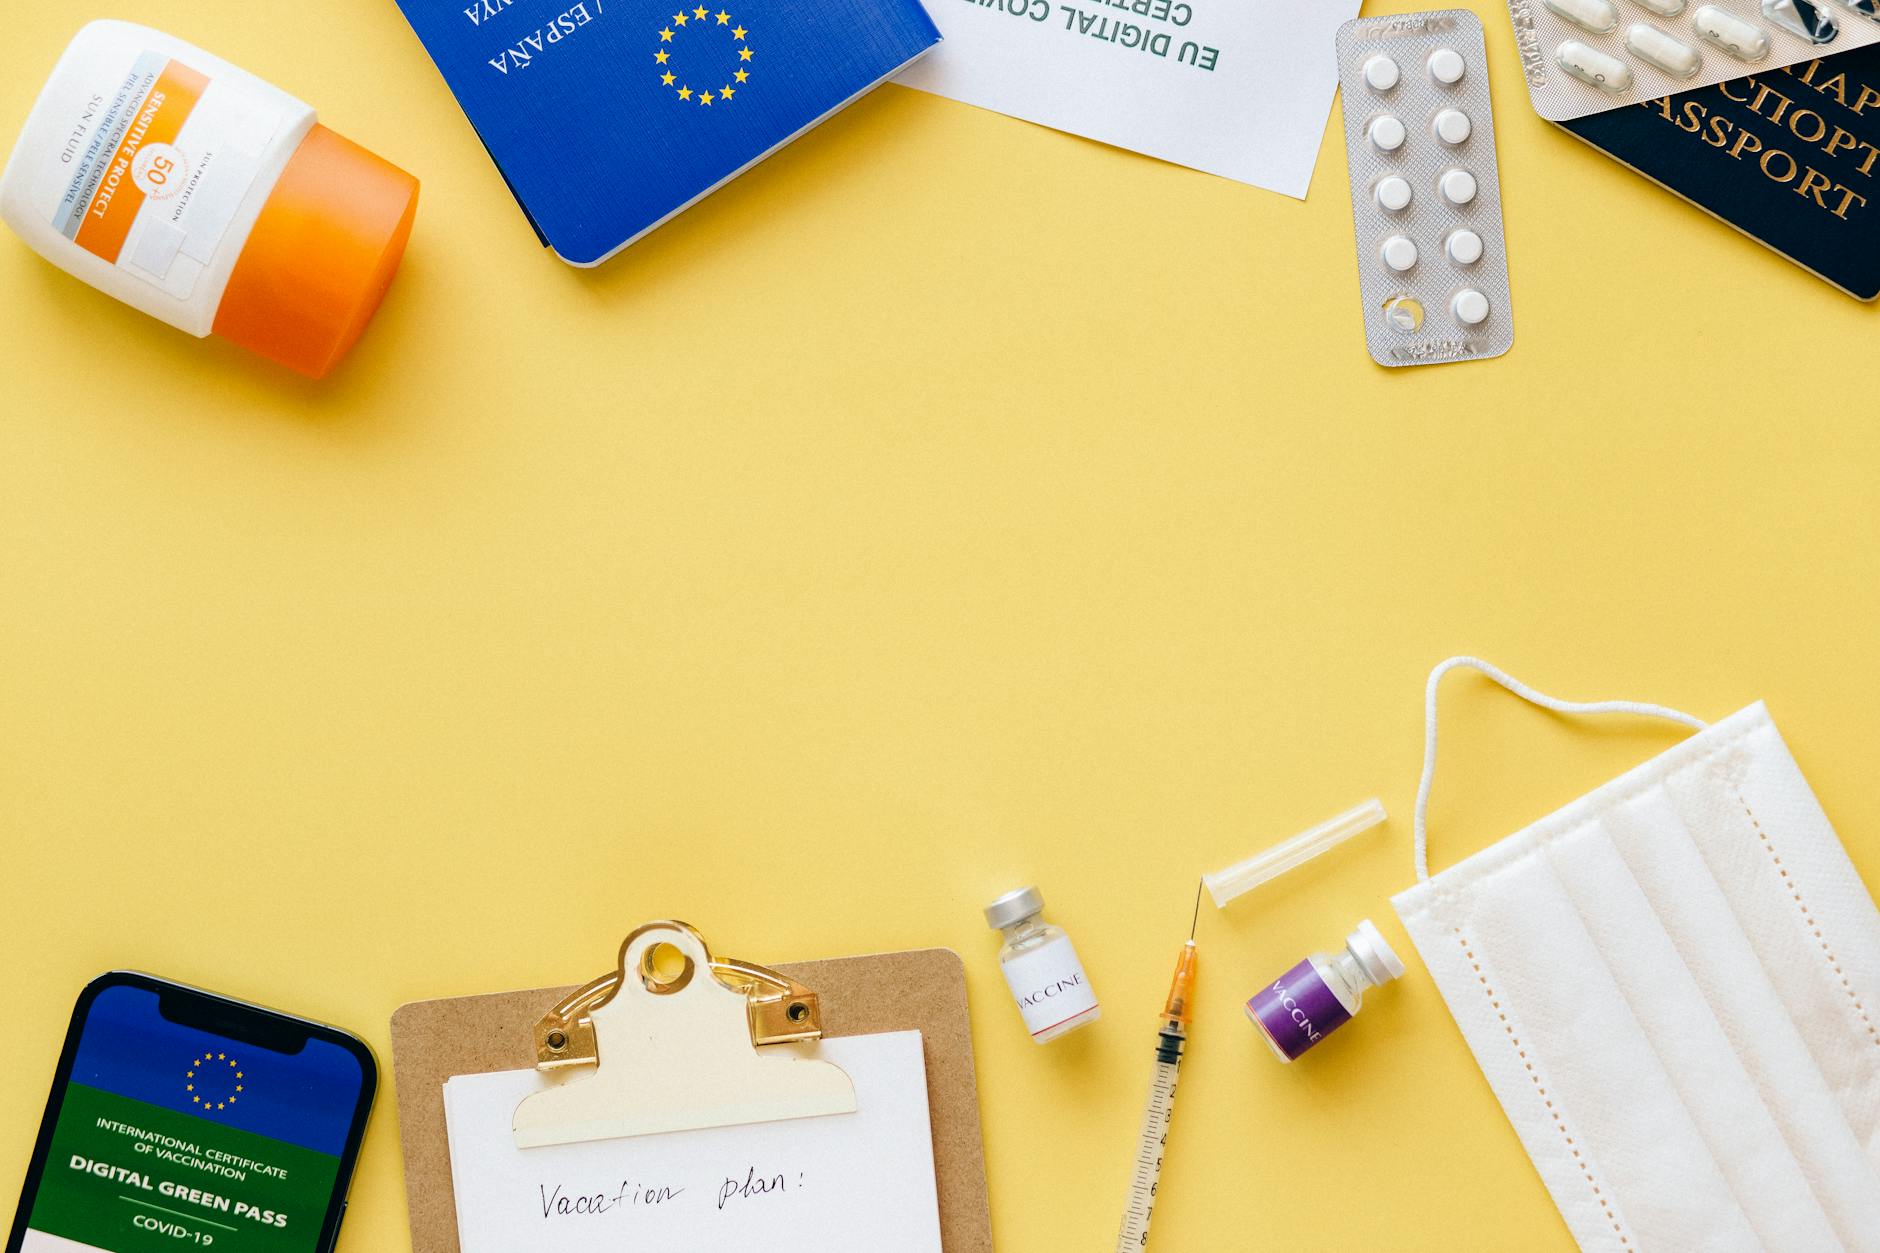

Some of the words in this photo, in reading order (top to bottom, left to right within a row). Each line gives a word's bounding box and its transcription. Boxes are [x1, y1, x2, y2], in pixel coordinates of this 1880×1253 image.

[488, 2, 593, 75] ESPAÑA
[1060, 5, 1172, 58] DIGITAL
[1177, 41, 1220, 71] EU
[125, 73, 138, 92] PIEL
[125, 72, 155, 117] ADVANCED
[82, 93, 103, 122] SUN
[100, 92, 127, 136] SENSIBLE
[123, 91, 166, 157] SENSITIVE
[61, 123, 87, 164] FLUID
[85, 140, 101, 163] PELE
[103, 116, 129, 159] SPECTRAL
[200, 151, 213, 168] SUN
[74, 159, 106, 220] TECHNOLOGY
[93, 156, 129, 219] PROTECT
[172, 168, 202, 222] PROTECTION
[1272, 979, 1322, 1042] VACCINE
[96, 1117, 202, 1156] INTERNATIONAL
[205, 1149, 288, 1180] CERTIFICATE
[134, 1142, 154, 1155] OF
[156, 1149, 246, 1182] VACCINATION
[69, 1154, 153, 1190] DIGITAL
[158, 1181, 231, 1212] GREEN
[233, 1201, 288, 1228] PASS
[540, 1180, 686, 1219] Vacation
[1150, 1182, 1158, 1197] 6
[132, 1214, 214, 1247] COVID-19
